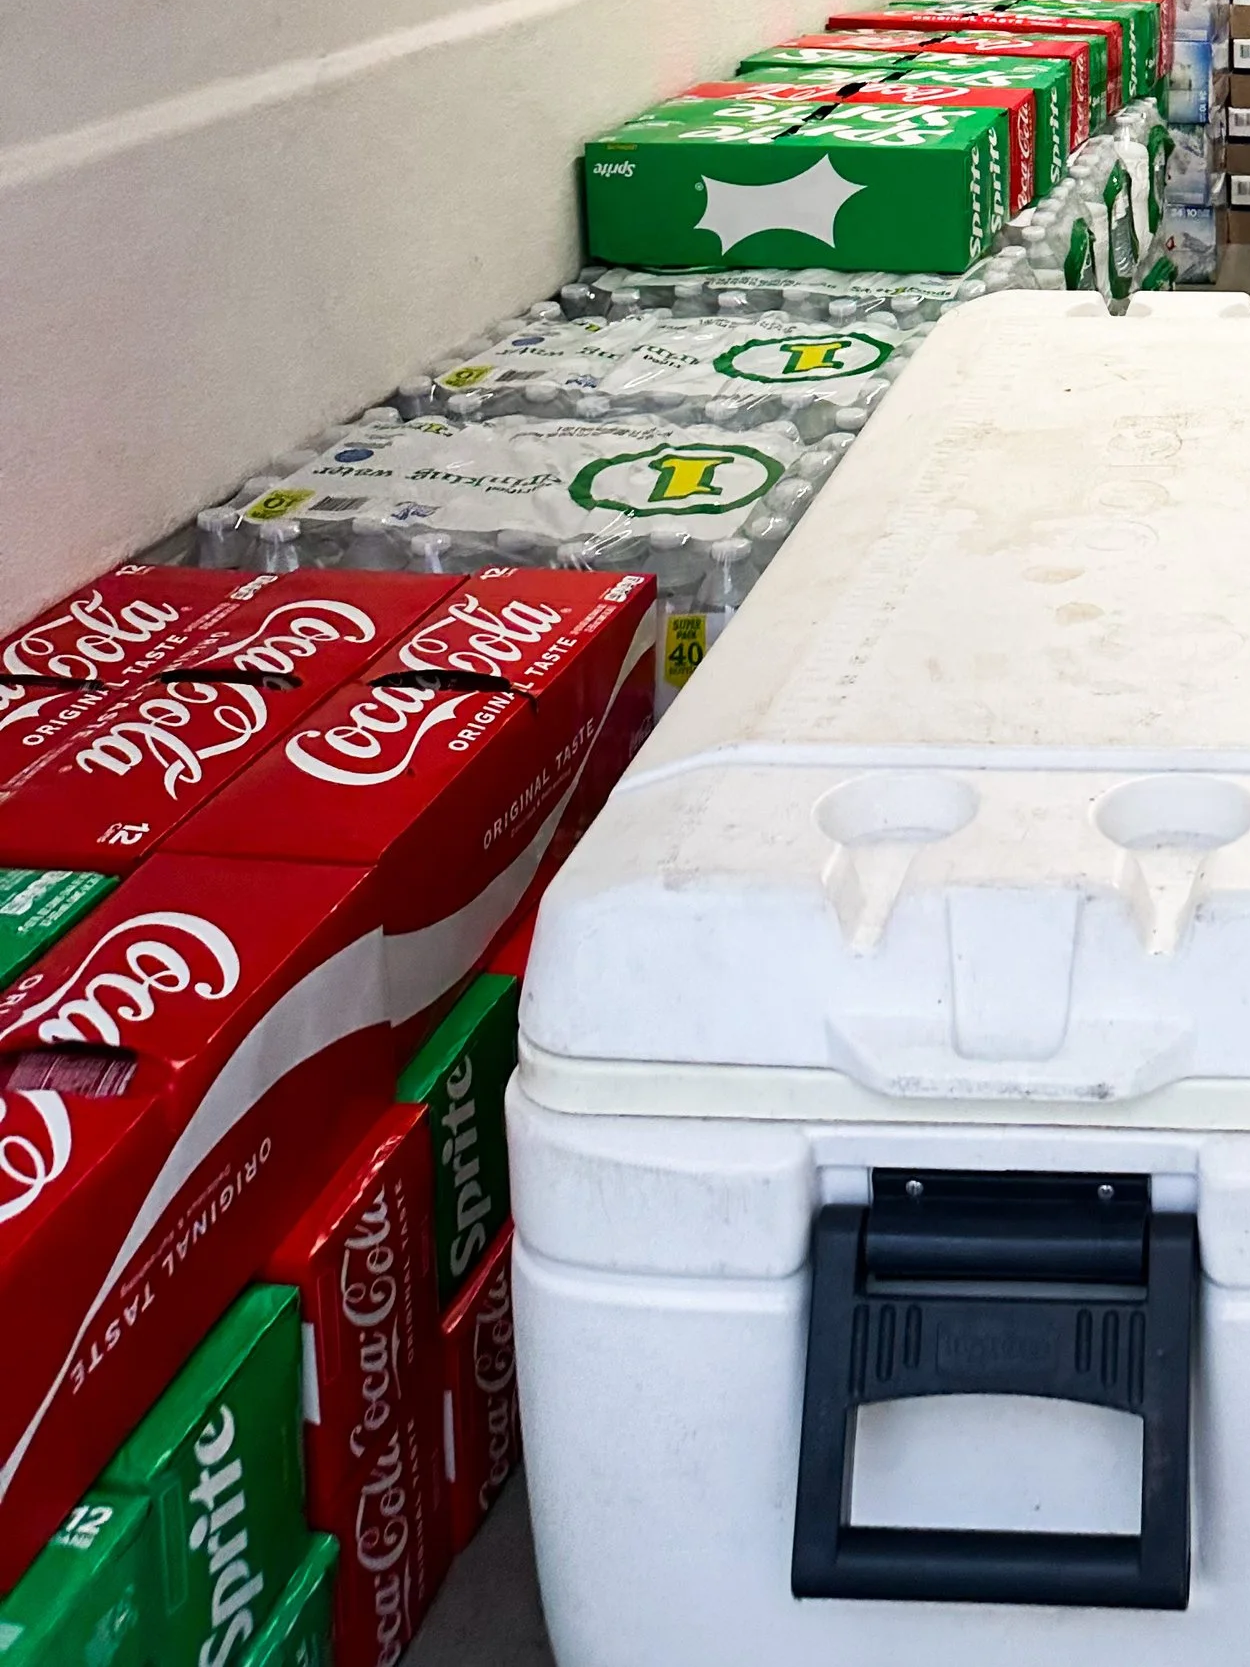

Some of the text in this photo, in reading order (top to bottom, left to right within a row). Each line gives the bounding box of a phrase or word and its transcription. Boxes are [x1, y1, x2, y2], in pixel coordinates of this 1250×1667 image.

[593, 162, 636, 178] Sprite
[991, 127, 1005, 234] Sprite
[1050, 85, 1060, 184] Sprite
[969, 145, 984, 259] Sprite
[647, 455, 736, 503] 1
[123, 635, 188, 675] TASTE
[524, 636, 578, 685] TASTE
[668, 642, 704, 666] 40
[483, 768, 550, 849] ORIGINAL
[555, 718, 595, 766] TASTE
[160, 1136, 273, 1278] ORIGINAL
[442, 1055, 493, 1278] Sprite
[70, 1289, 155, 1396] TASTE
[65, 1505, 113, 1534] 12
[188, 1403, 264, 1667] Sprite
